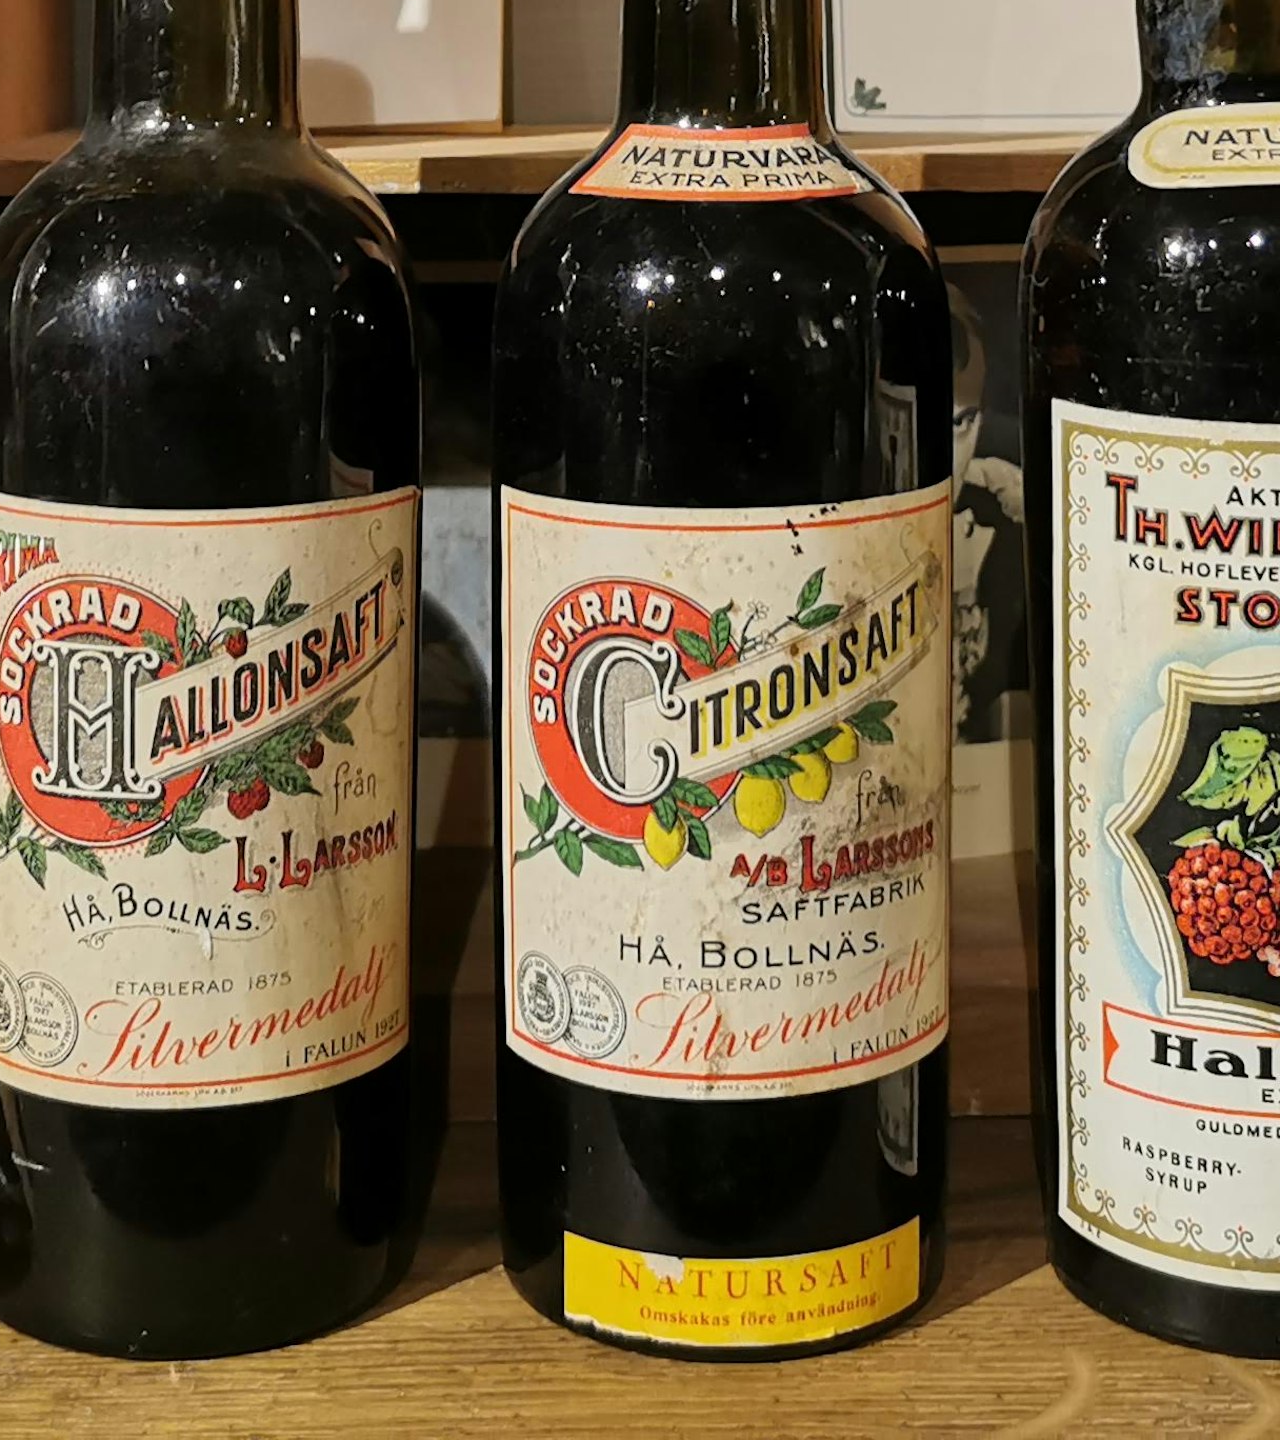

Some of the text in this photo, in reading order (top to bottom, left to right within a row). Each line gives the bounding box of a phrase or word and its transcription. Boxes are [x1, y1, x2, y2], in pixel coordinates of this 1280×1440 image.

[621, 143, 837, 169] NATURVARA
[629, 170, 837, 189] EXTRA PRIMA
[1128, 553, 1174, 574] KGL.
[0, 586, 143, 727] SOCKRAD
[533, 586, 675, 726] SOCKRAD
[30, 577, 388, 804] HALLONSAFT
[570, 579, 920, 805] CITRONSAFT
[332, 760, 377, 816] från
[855, 769, 907, 828] från
[730, 819, 935, 894] A/B LARSSONS
[62, 883, 262, 933] HÅ, BOLLNÄS.
[741, 873, 926, 925] SAFTFABRIK
[619, 931, 886, 970] HÅ, BOLLNÄS.
[115, 970, 293, 997] ETABLERAD 1875
[629, 938, 929, 1070] Silvermedalj
[662, 968, 838, 993] ETABLERAD 1875
[76, 943, 399, 1077] Silvermedalj
[303, 1030, 367, 1064] FALUN
[850, 1025, 909, 1061] FALUN
[1122, 1135, 1243, 1176] RASPBERRY-
[1145, 1166, 1208, 1195] SYRUP
[617, 1239, 897, 1300] NATURSAFT
[639, 1304, 731, 1327] Omskakas
[740, 1308, 778, 1327] före
